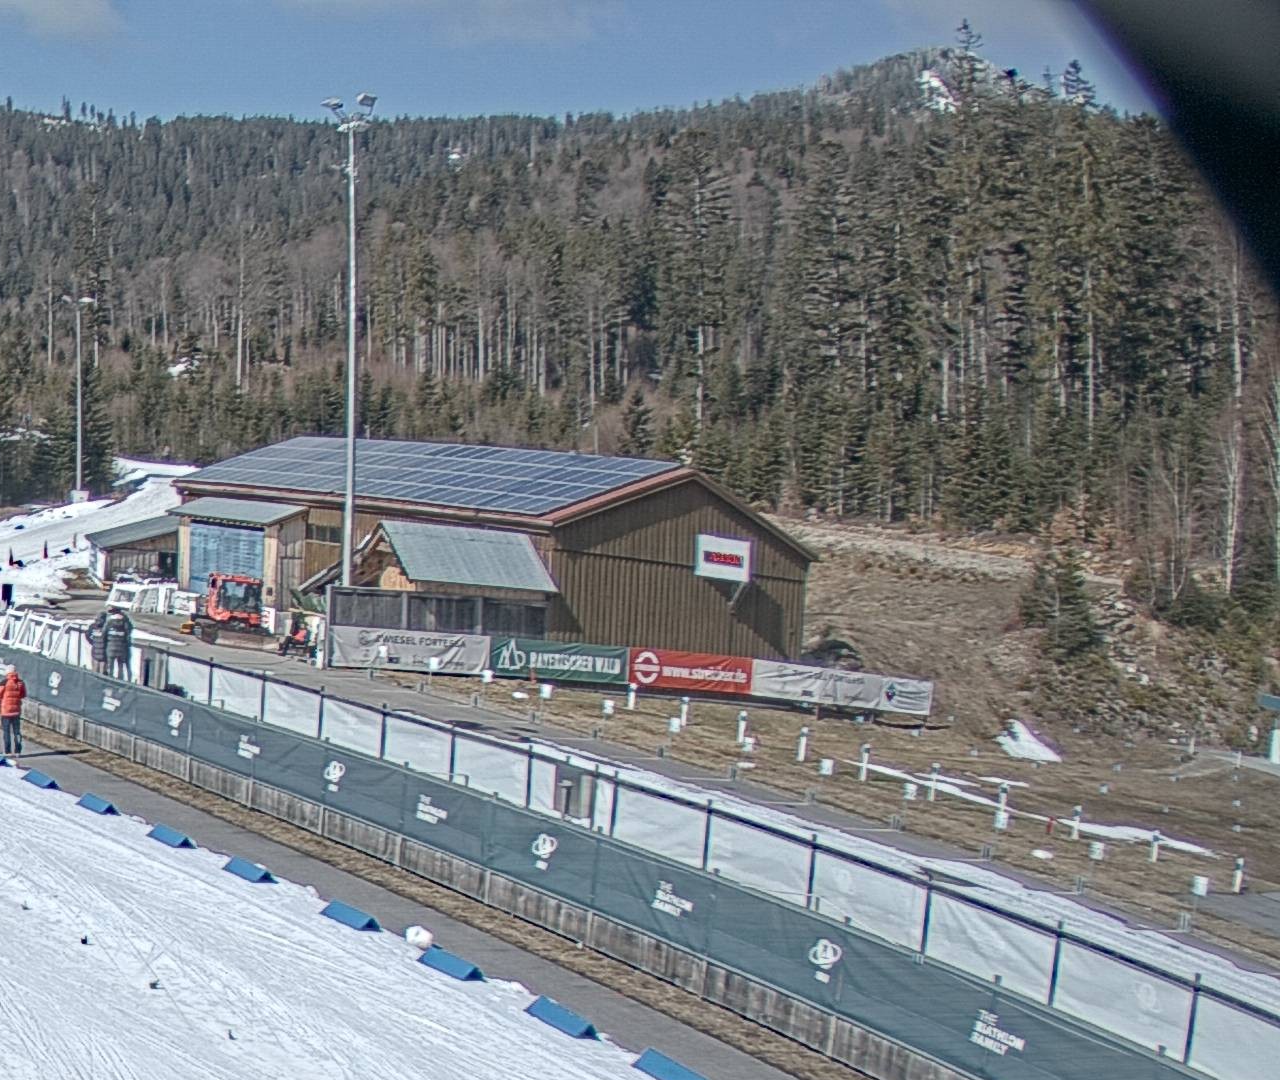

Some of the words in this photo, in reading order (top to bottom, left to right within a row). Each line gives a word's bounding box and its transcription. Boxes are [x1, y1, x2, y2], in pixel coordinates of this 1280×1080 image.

[595, 656, 621, 675] WALD
[976, 1008, 999, 1026] THE
[968, 1031, 1009, 1056] FAMILY
[973, 1020, 1026, 1051] BIATHLON
